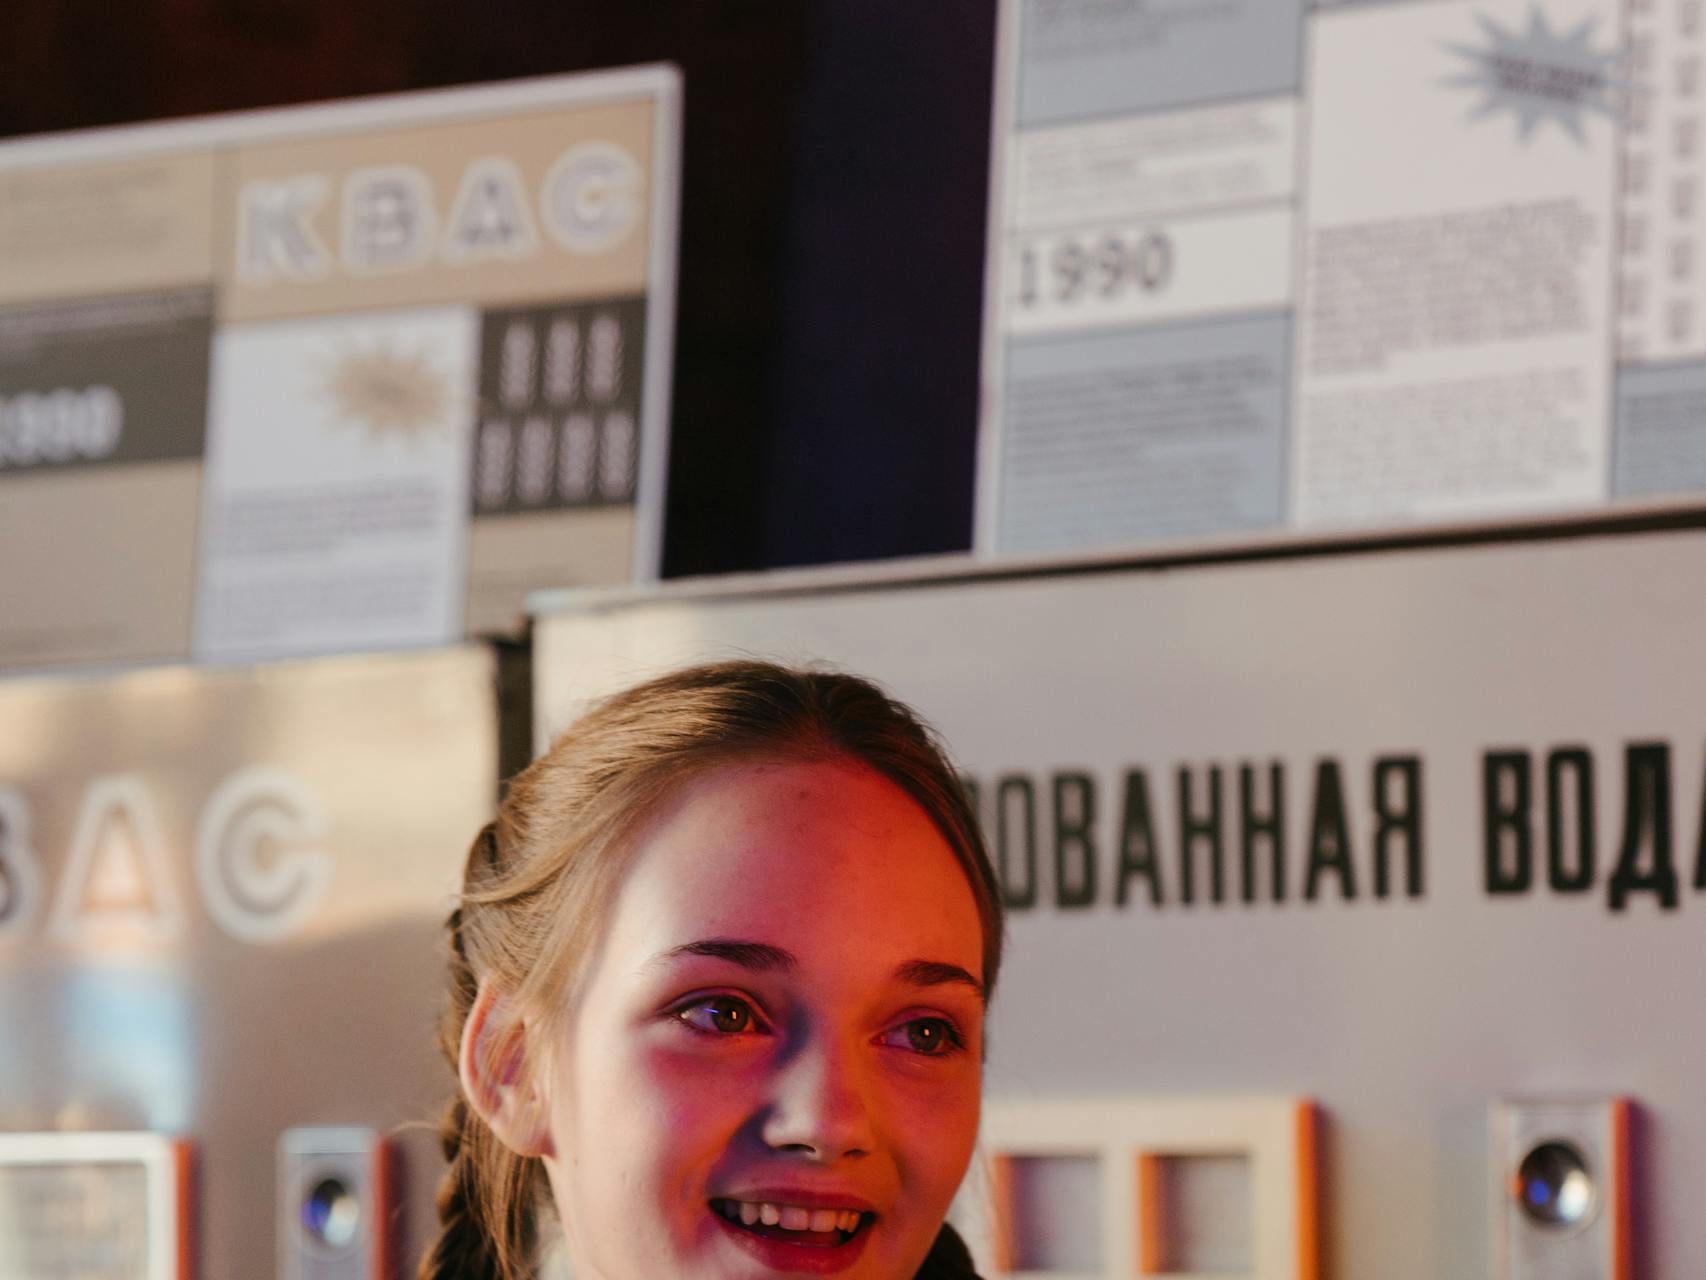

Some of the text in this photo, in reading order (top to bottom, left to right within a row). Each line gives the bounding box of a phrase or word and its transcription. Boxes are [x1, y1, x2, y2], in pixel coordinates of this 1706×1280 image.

[236, 139, 646, 285] КВАС
[1018, 231, 1176, 309] 1990
[959, 738, 1706, 913] ОВАННАЯ ВОД
